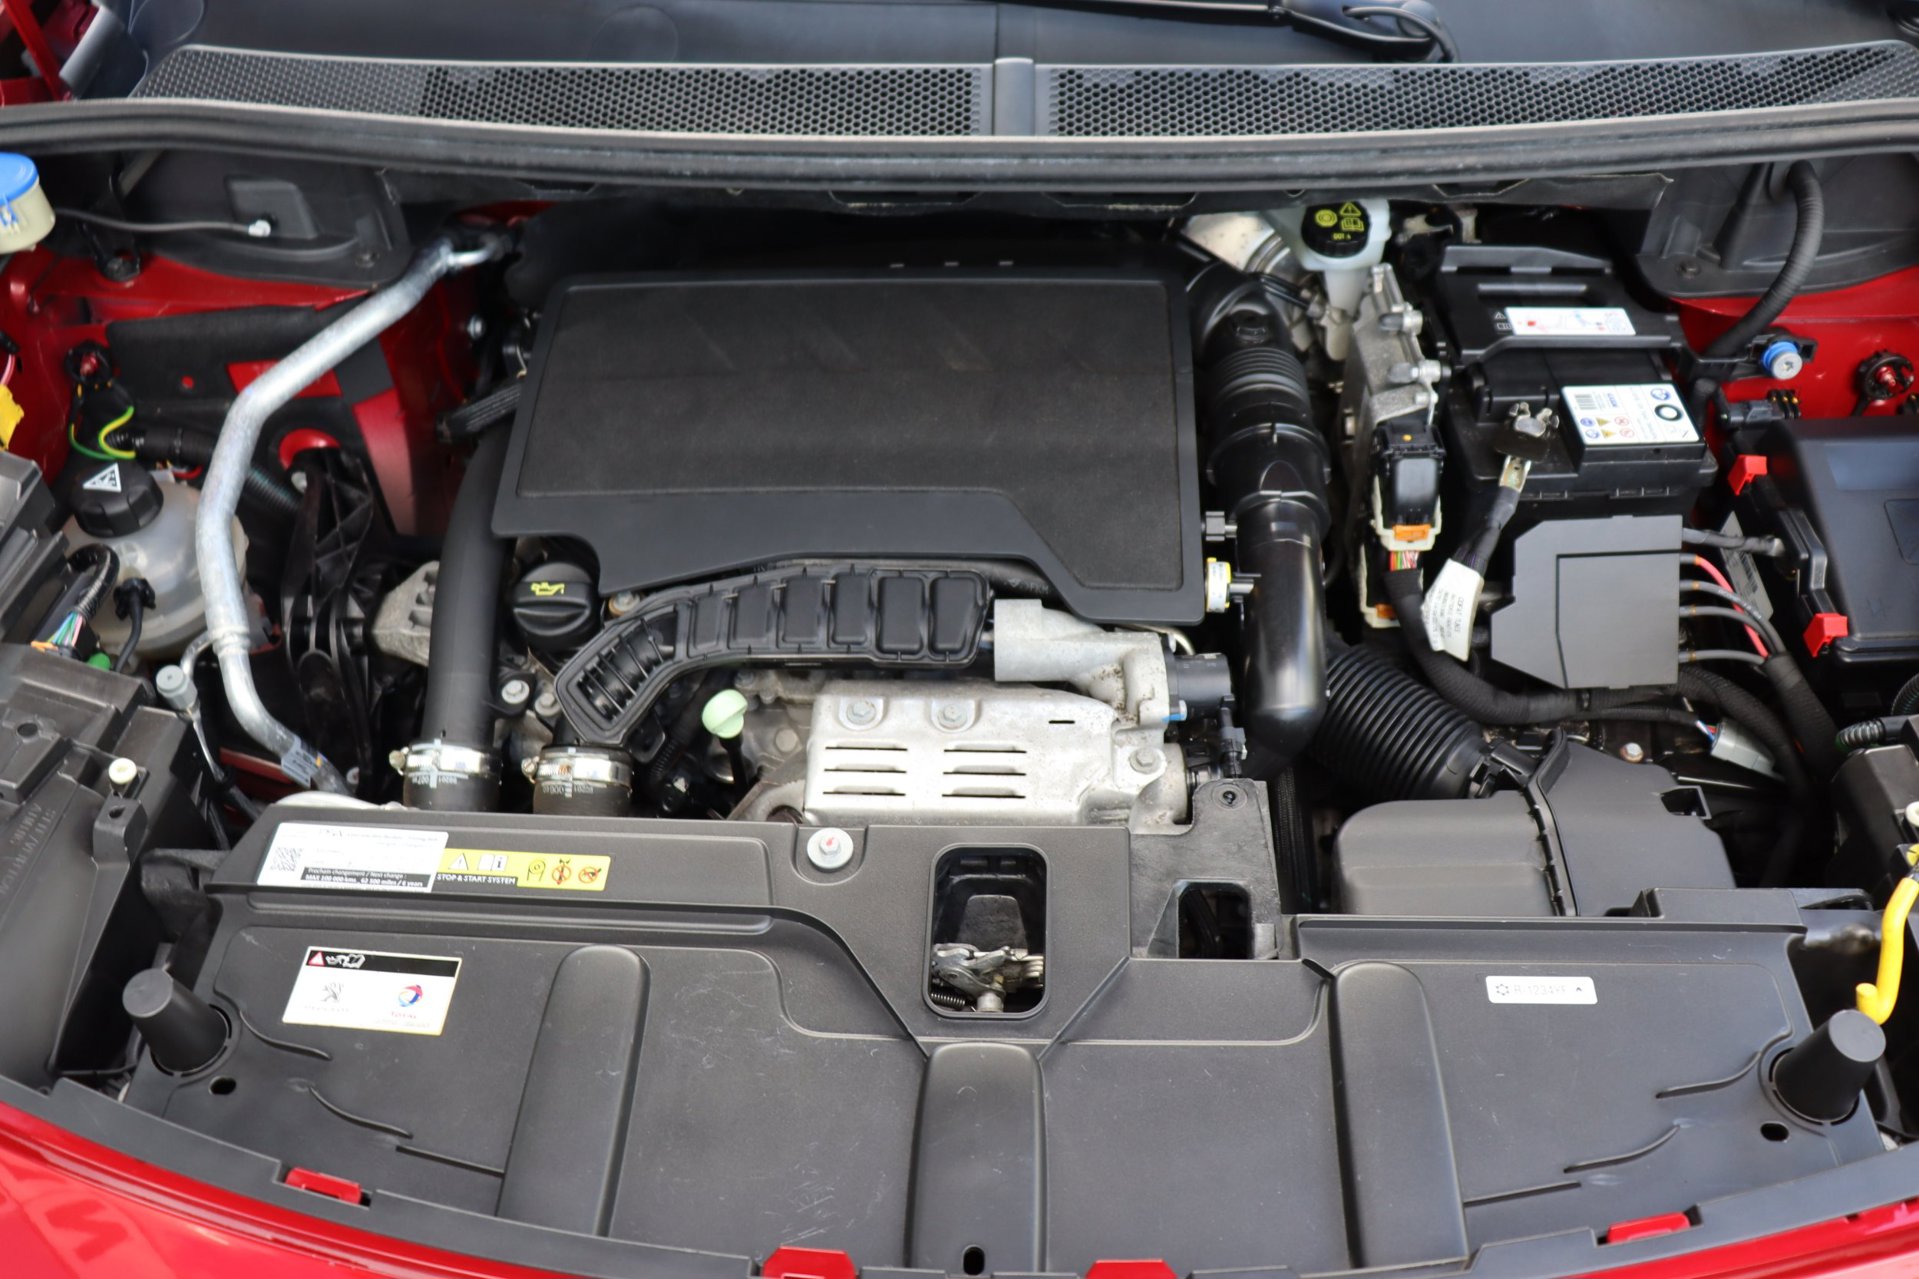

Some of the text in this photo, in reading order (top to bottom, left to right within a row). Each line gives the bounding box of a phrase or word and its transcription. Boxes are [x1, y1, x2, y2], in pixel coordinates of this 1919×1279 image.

[436, 873, 456, 882] STOP
[464, 875, 486, 884] START
[487, 877, 516, 886] SYSTEM
